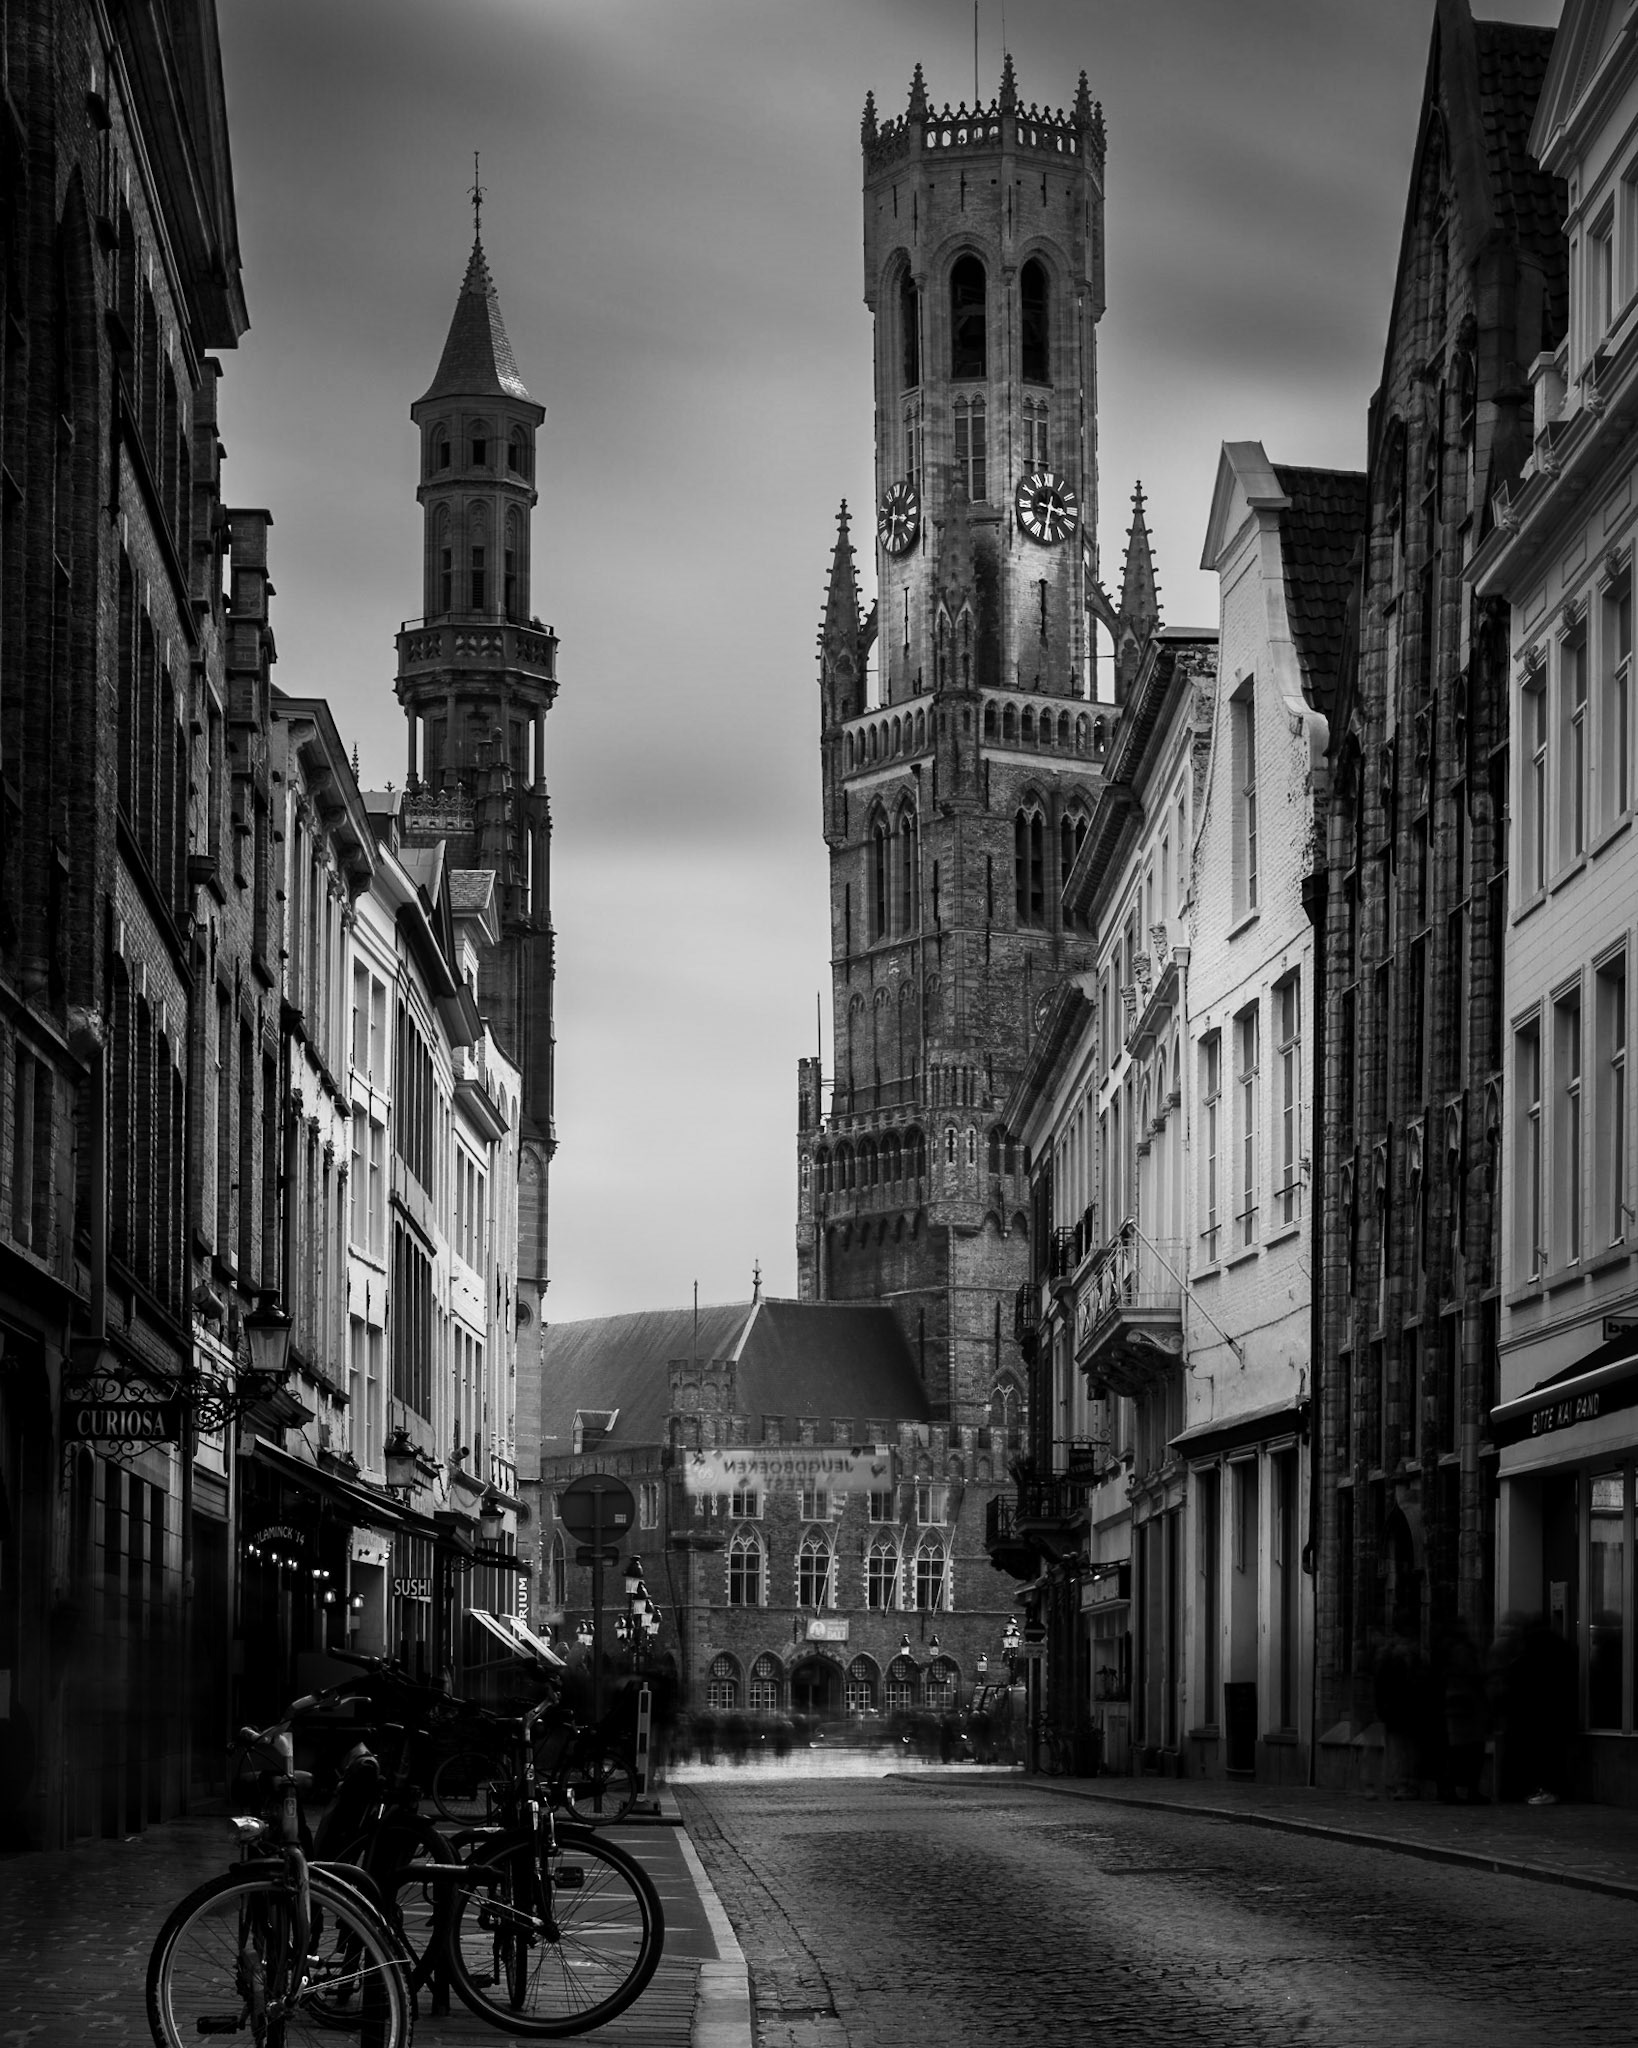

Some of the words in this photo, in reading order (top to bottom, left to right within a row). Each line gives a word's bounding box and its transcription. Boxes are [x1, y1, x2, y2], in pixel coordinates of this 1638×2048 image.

[76, 1409, 167, 1436] CURIOSA
[1532, 1407, 1554, 1434] BITTE
[1557, 1400, 1573, 1425] KAI
[394, 1578, 431, 1596] SUSHI
